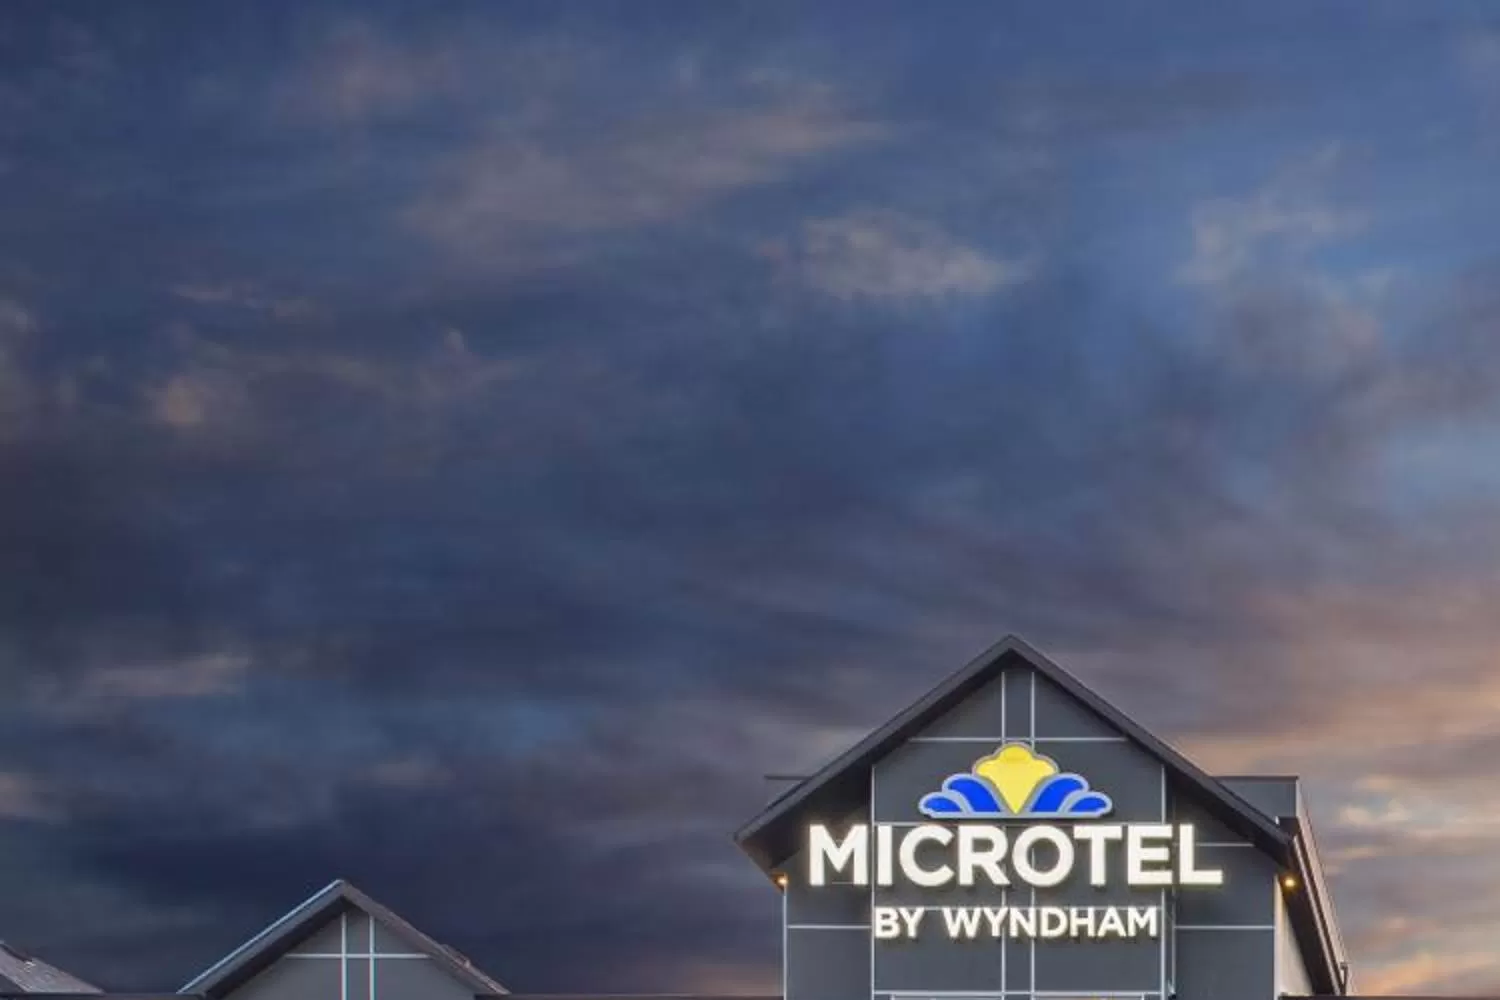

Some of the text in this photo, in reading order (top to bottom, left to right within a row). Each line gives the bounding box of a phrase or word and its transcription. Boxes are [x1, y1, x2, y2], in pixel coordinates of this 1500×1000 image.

[808, 824, 1223, 887] MICROTEL
[873, 905, 1158, 938] BY WYNDHAM
